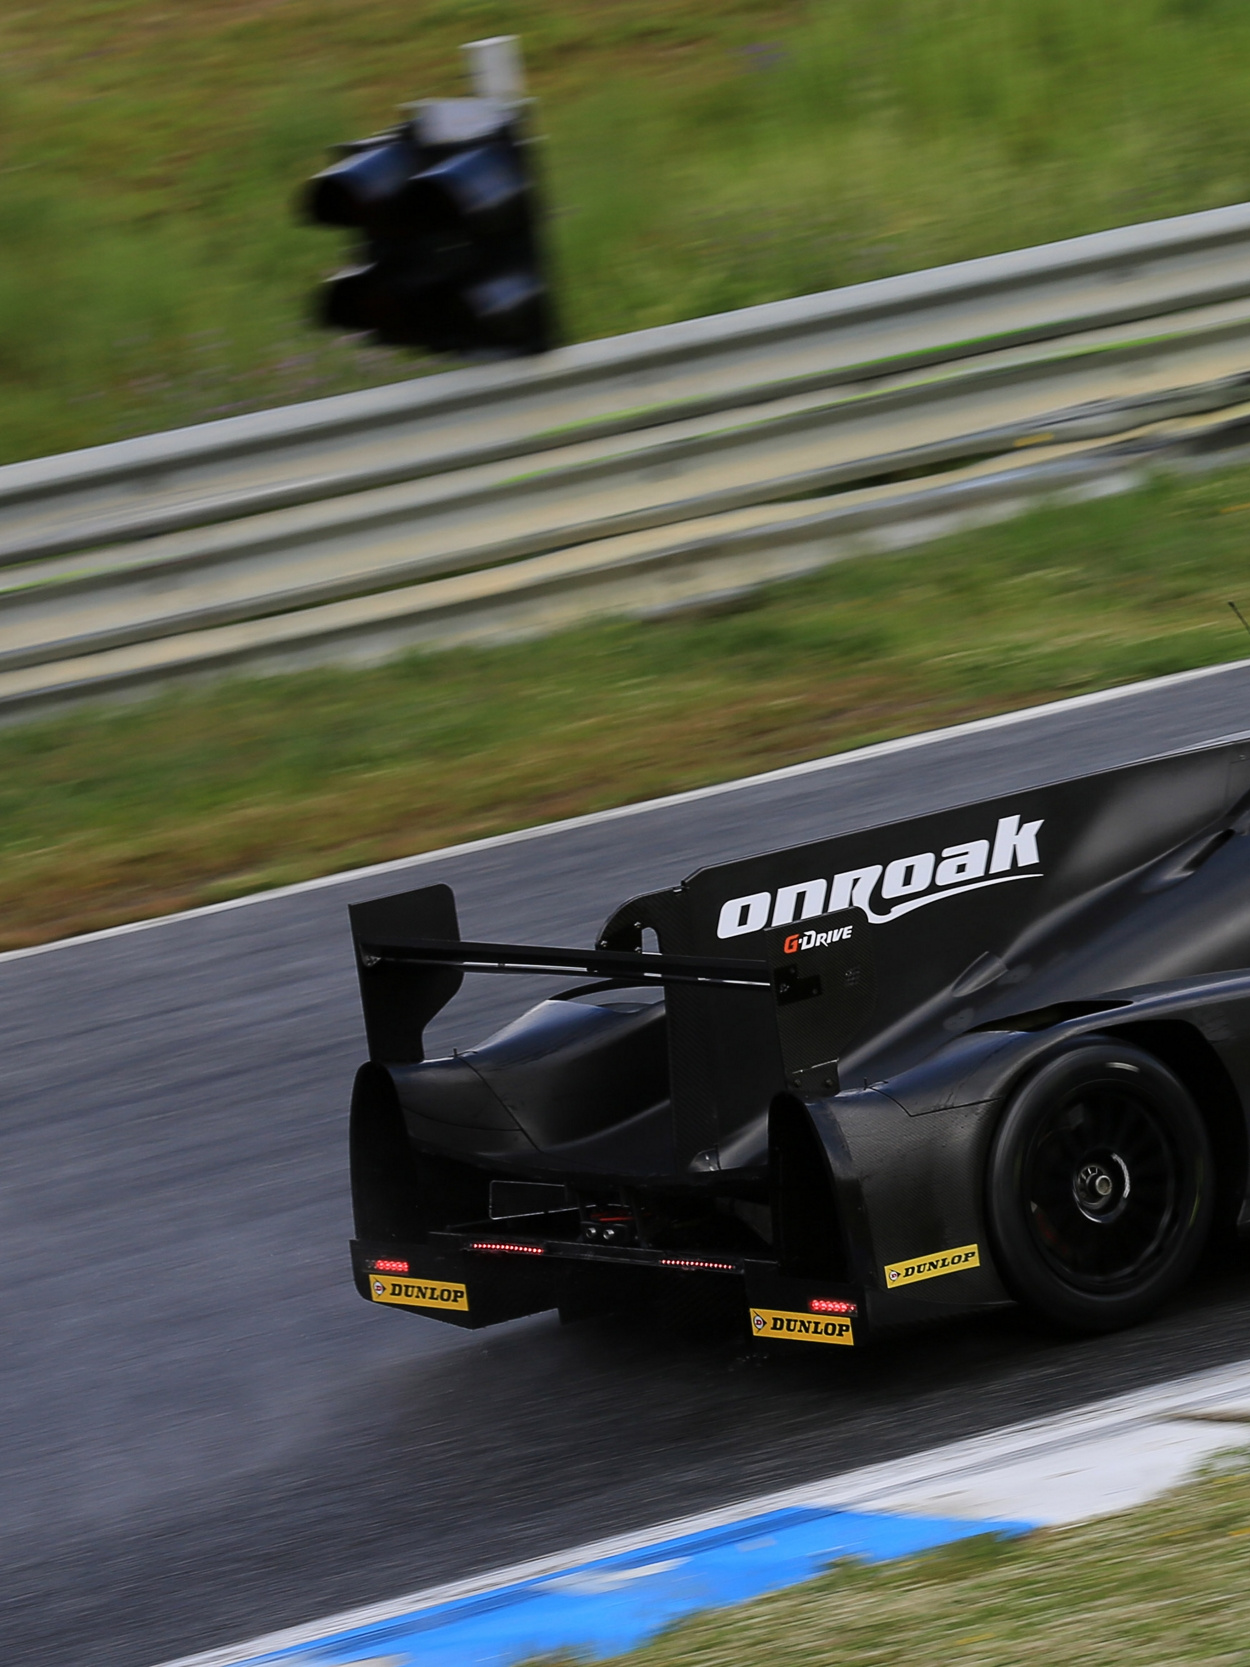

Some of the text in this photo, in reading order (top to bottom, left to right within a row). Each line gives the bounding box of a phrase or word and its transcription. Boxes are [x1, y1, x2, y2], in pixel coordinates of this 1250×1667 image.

[903, 1251, 976, 1278] DUNLOP
[390, 1283, 465, 1303] DUNLOP
[770, 1317, 850, 1337] DUNLOP
